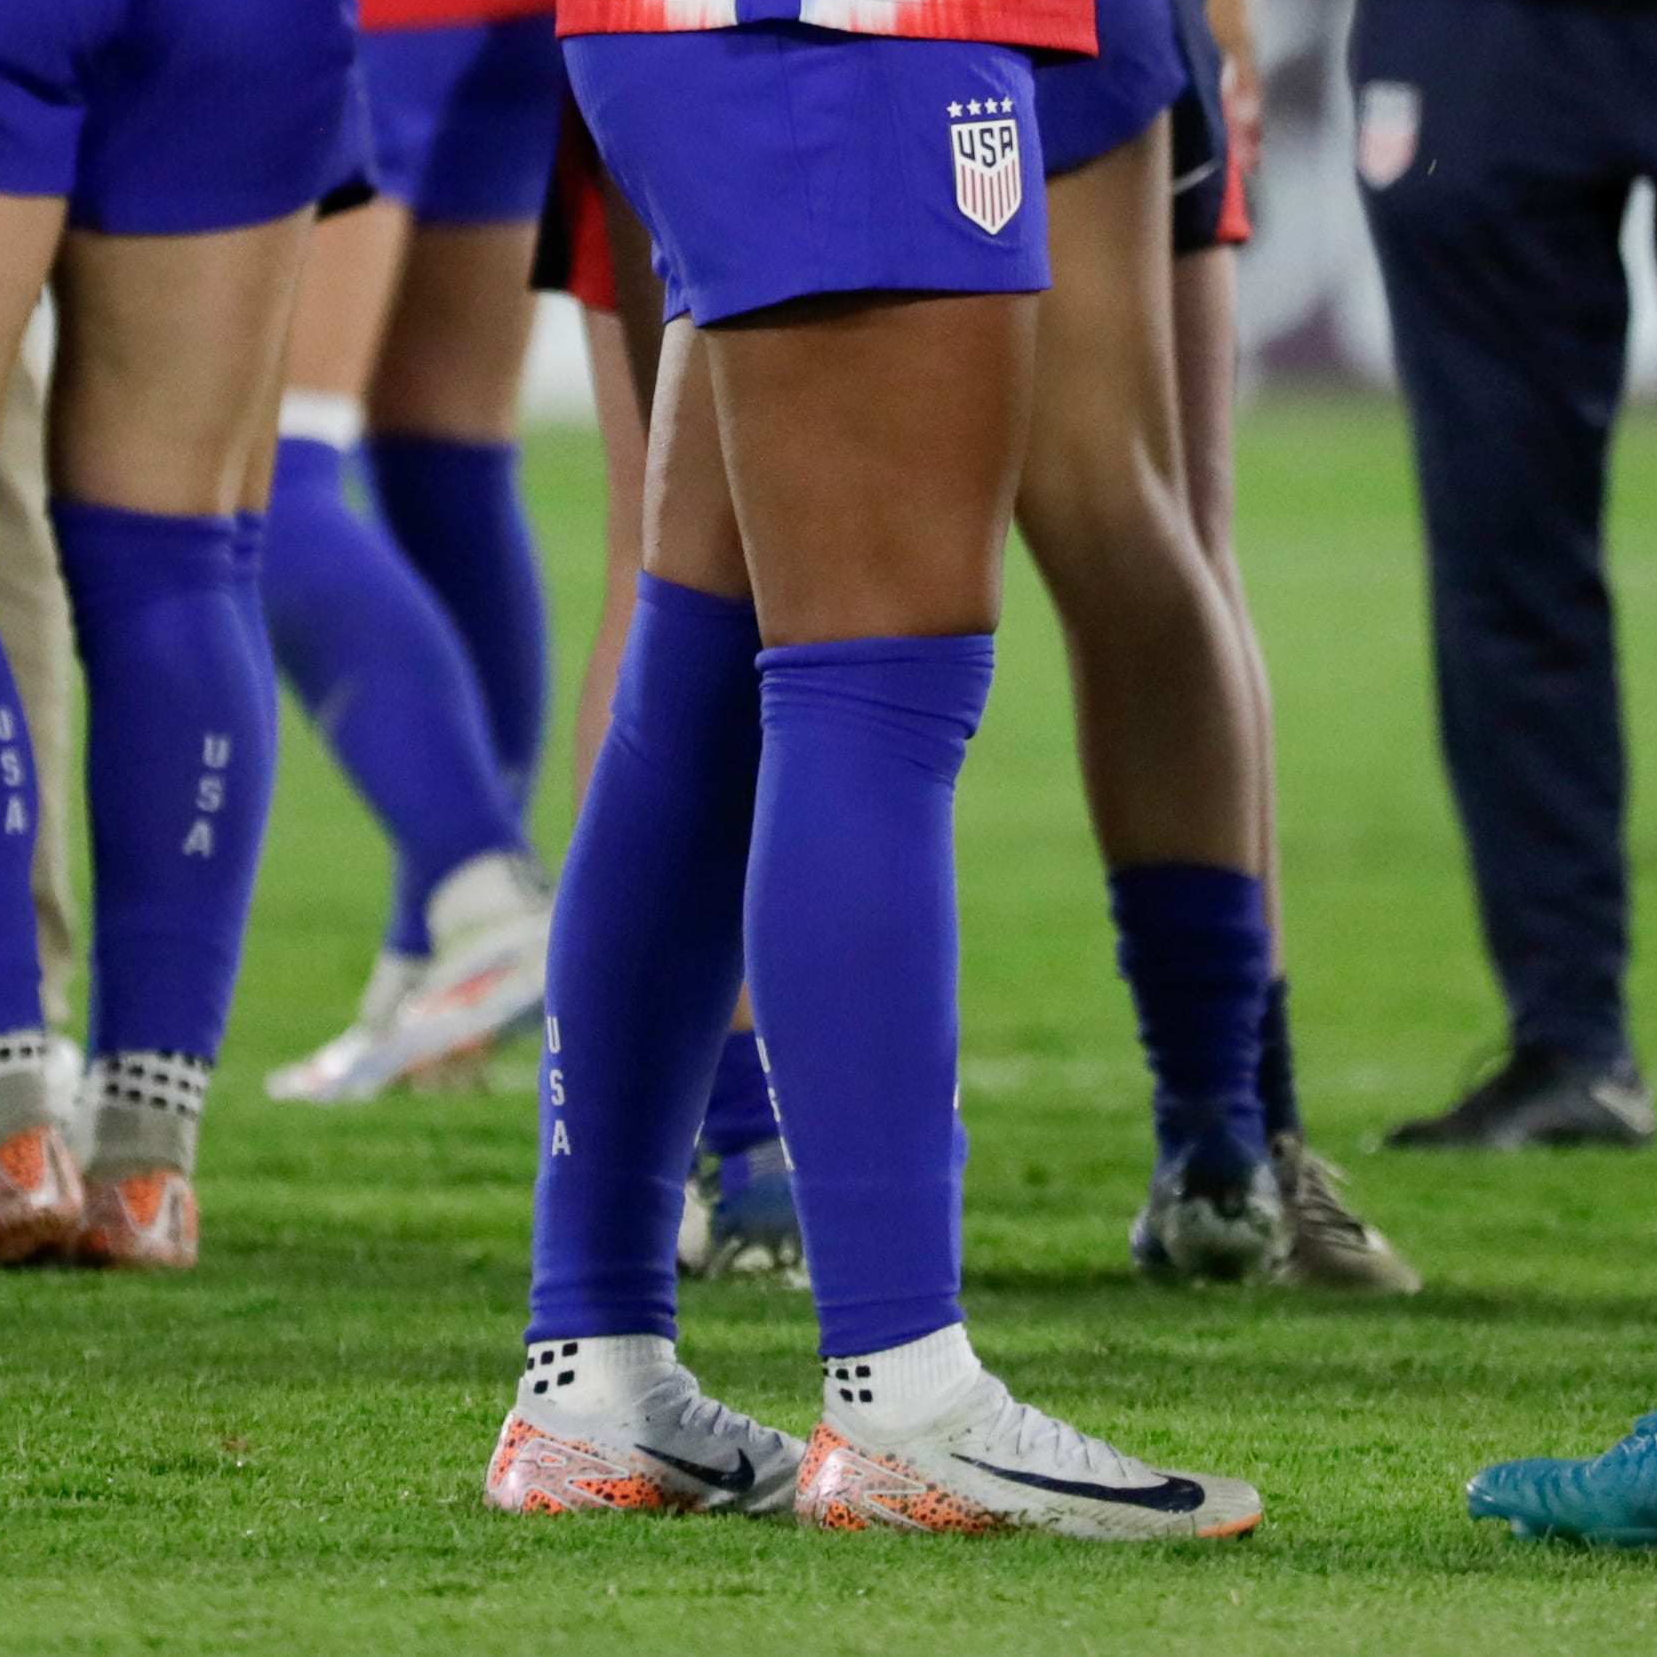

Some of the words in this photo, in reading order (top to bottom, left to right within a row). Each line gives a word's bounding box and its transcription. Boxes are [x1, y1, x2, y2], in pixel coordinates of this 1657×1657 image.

[957, 125, 1014, 169] USA
[182, 732, 231, 859] USA
[546, 1015, 572, 1157] USA
